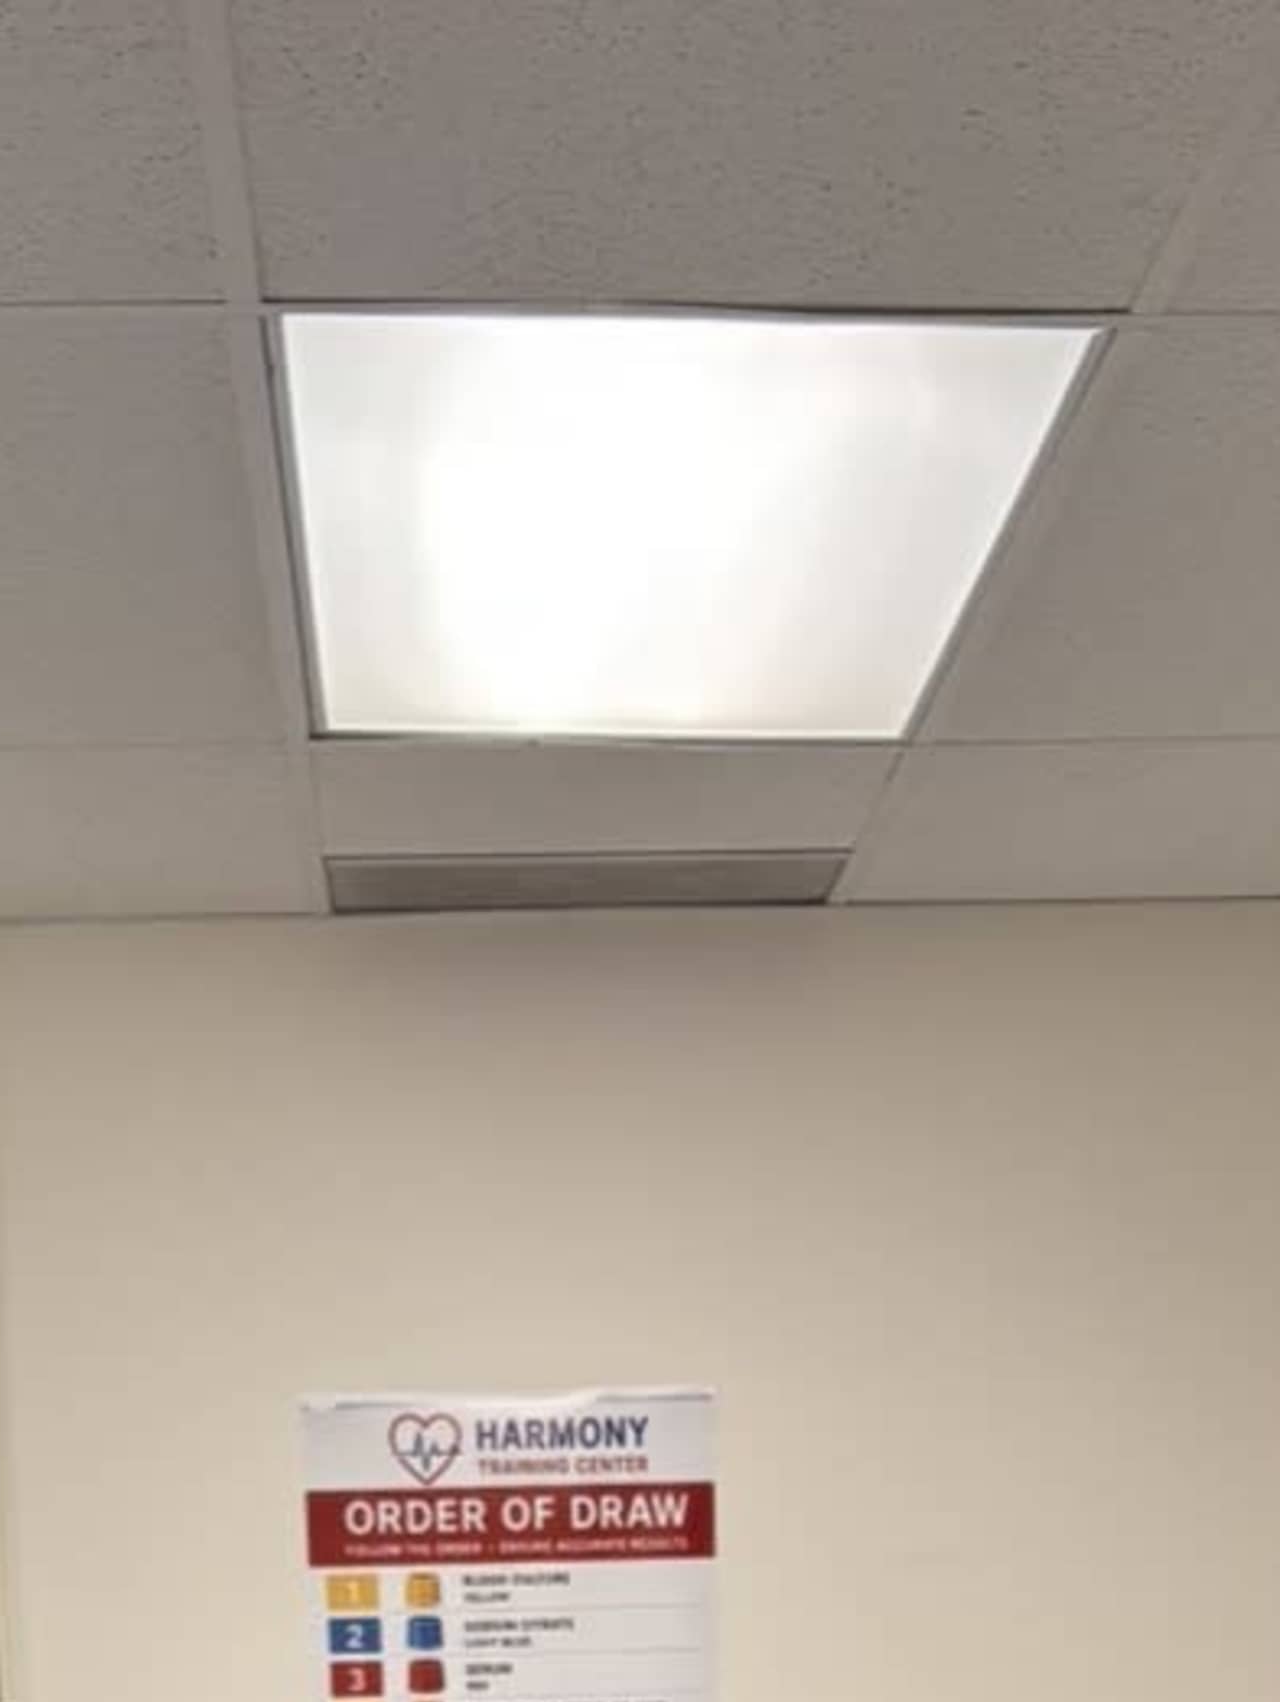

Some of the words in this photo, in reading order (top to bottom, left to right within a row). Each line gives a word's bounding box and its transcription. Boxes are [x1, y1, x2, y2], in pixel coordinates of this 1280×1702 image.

[475, 1417, 649, 1451] HARMONY
[478, 1459, 569, 1475] TRAINING
[574, 1456, 648, 1474] CENTER
[344, 1500, 487, 1536] ORDER
[501, 1497, 556, 1532] OF
[570, 1493, 689, 1529] DRAW
[436, 1541, 482, 1554] ORDER
[348, 1582, 361, 1602] 1
[344, 1624, 363, 1648] 2
[347, 1668, 366, 1691] 3
[466, 1663, 513, 1675] SERUM
